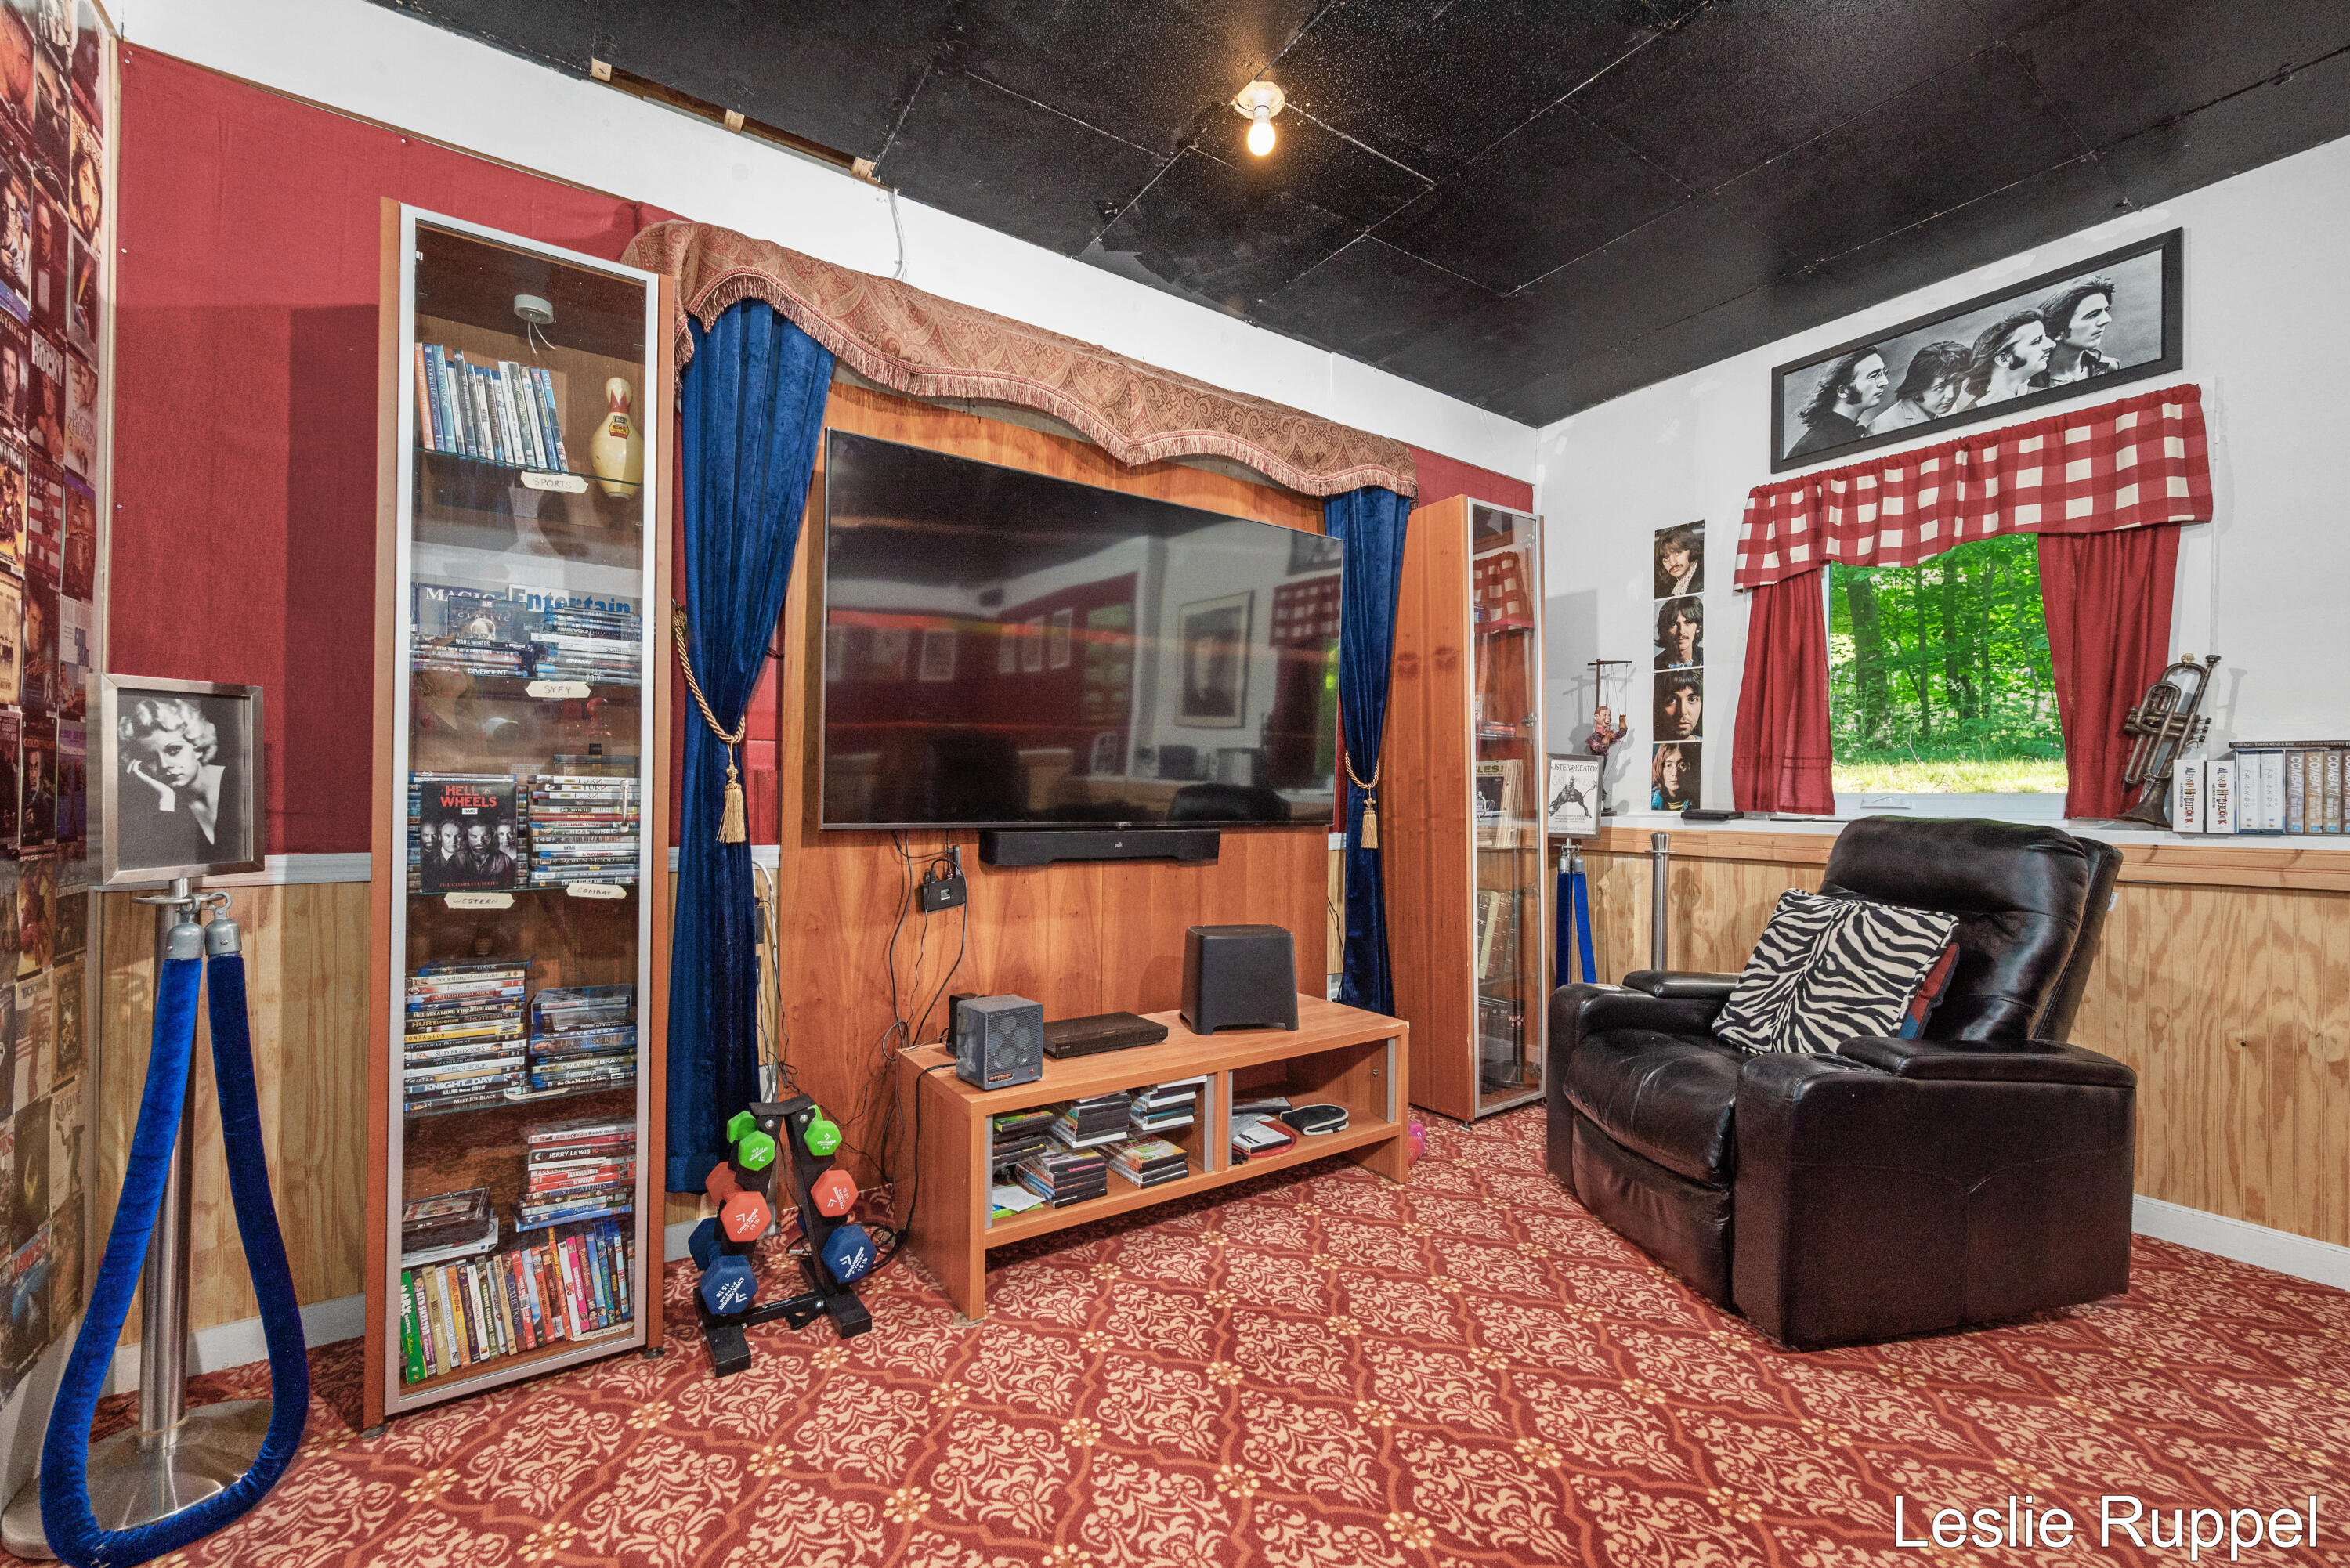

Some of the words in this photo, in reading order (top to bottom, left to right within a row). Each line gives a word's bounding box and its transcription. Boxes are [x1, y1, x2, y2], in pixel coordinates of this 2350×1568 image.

[32, 342, 63, 387] ROCKY
[428, 362, 436, 385] FOOTBALL
[533, 477, 573, 490] SPORTS
[544, 685, 572, 695] SYFY
[2185, 767, 2196, 788] ALFRED
[2217, 767, 2229, 788] ALFRED
[445, 785, 479, 797] HELL
[440, 796, 497, 807] WHEELS
[2183, 789, 2196, 824] HITCHCOCK
[2216, 789, 2229, 825] HITCHCOCK
[464, 1013, 508, 1022] BROTHERS
[424, 1080, 467, 1091] KNIGHT
[472, 1075, 495, 1085] DAY
[548, 1151, 569, 1159] JERRY
[573, 1176, 596, 1185] VINNY
[573, 1183, 607, 1194] FEATURES
[857, 1263, 865, 1272] 15
[862, 1256, 868, 1265] lb
[565, 1281, 574, 1296] BIG
[573, 1266, 584, 1301] BRIDESMAIDS
[400, 1284, 412, 1317] MARX
[416, 1292, 426, 1306] RED
[715, 1288, 722, 1298] lb
[509, 1281, 519, 1325] COLLECTION
[418, 1305, 430, 1335] SKELTON
